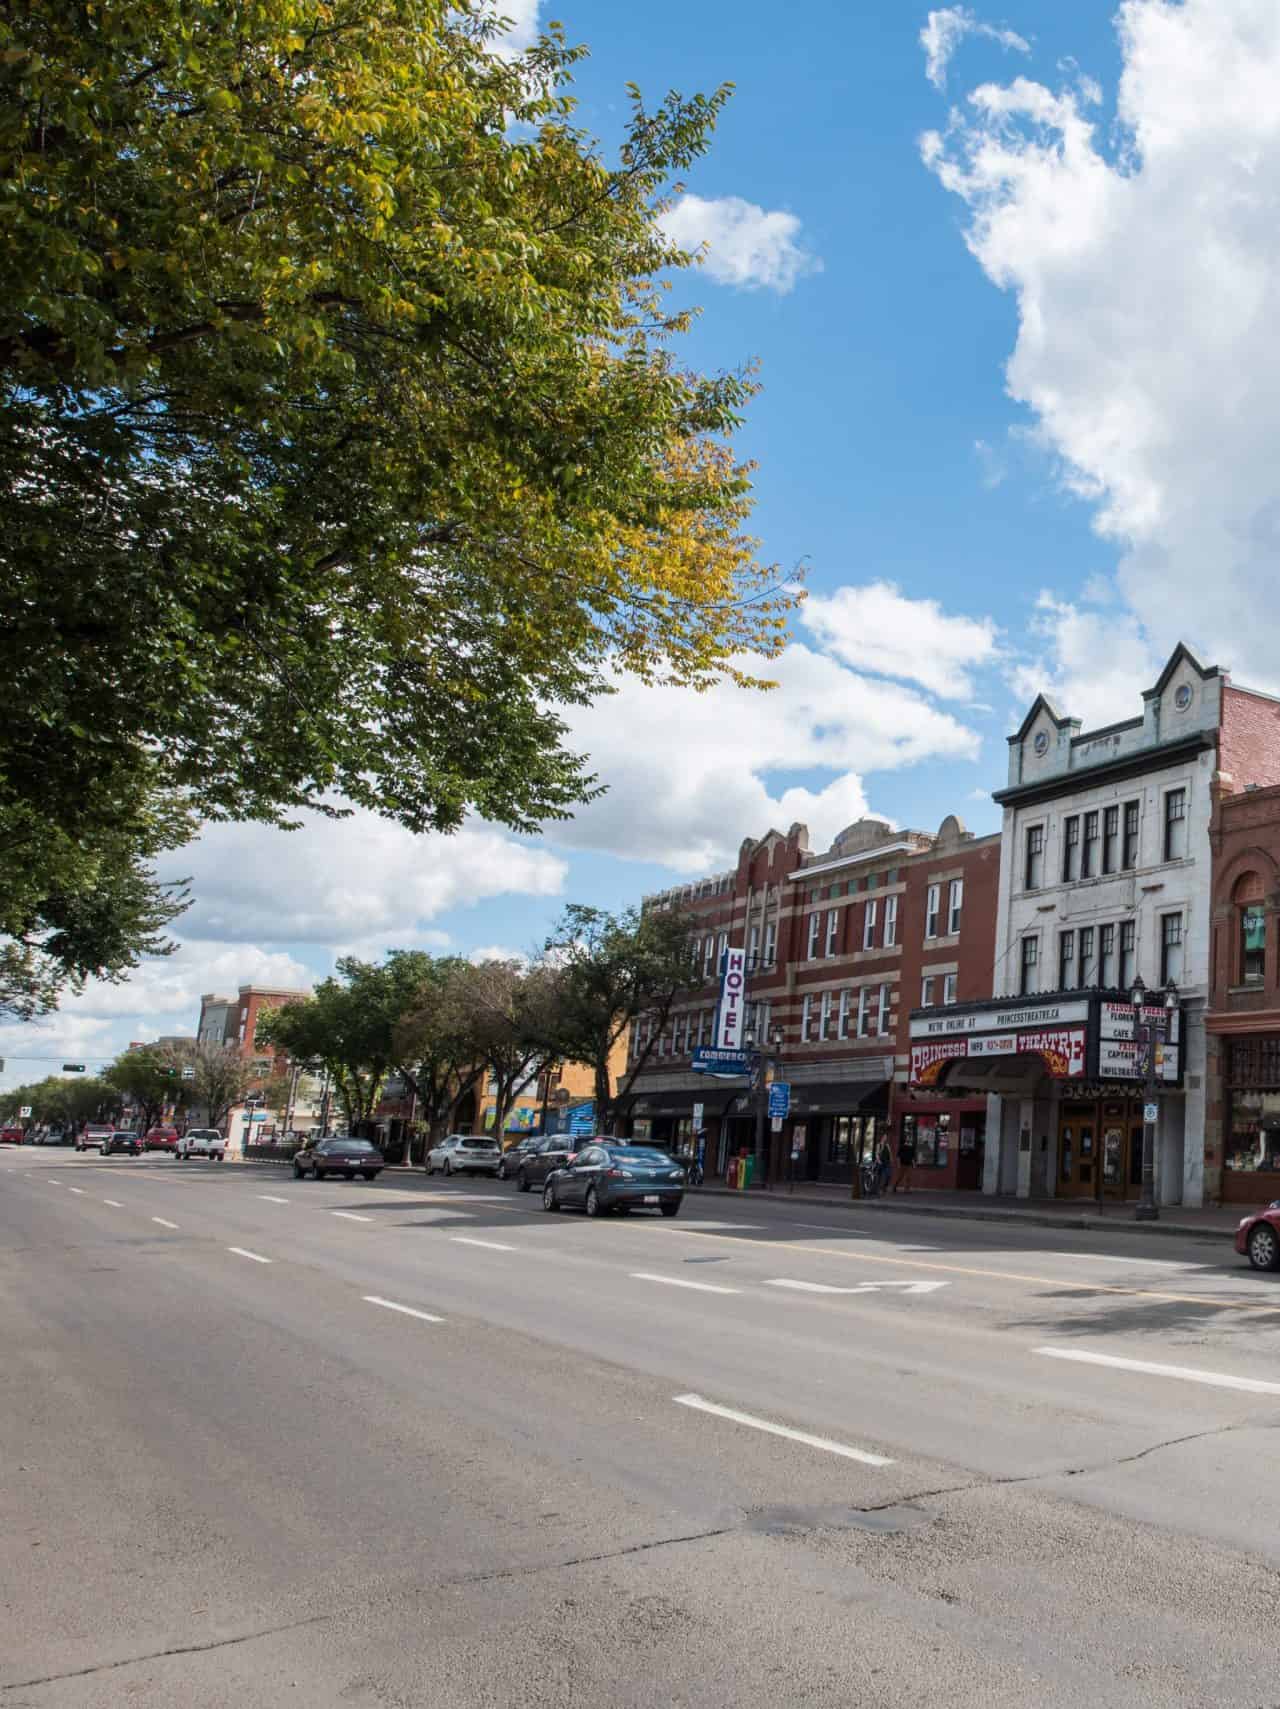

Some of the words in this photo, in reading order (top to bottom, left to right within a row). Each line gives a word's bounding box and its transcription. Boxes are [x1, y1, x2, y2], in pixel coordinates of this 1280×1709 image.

[723, 954, 743, 1047] HOTEL
[910, 1042, 966, 1083] PRINCESS
[1018, 1031, 1084, 1075] THEATRE
[1108, 1049, 1136, 1059] CAPTAIN
